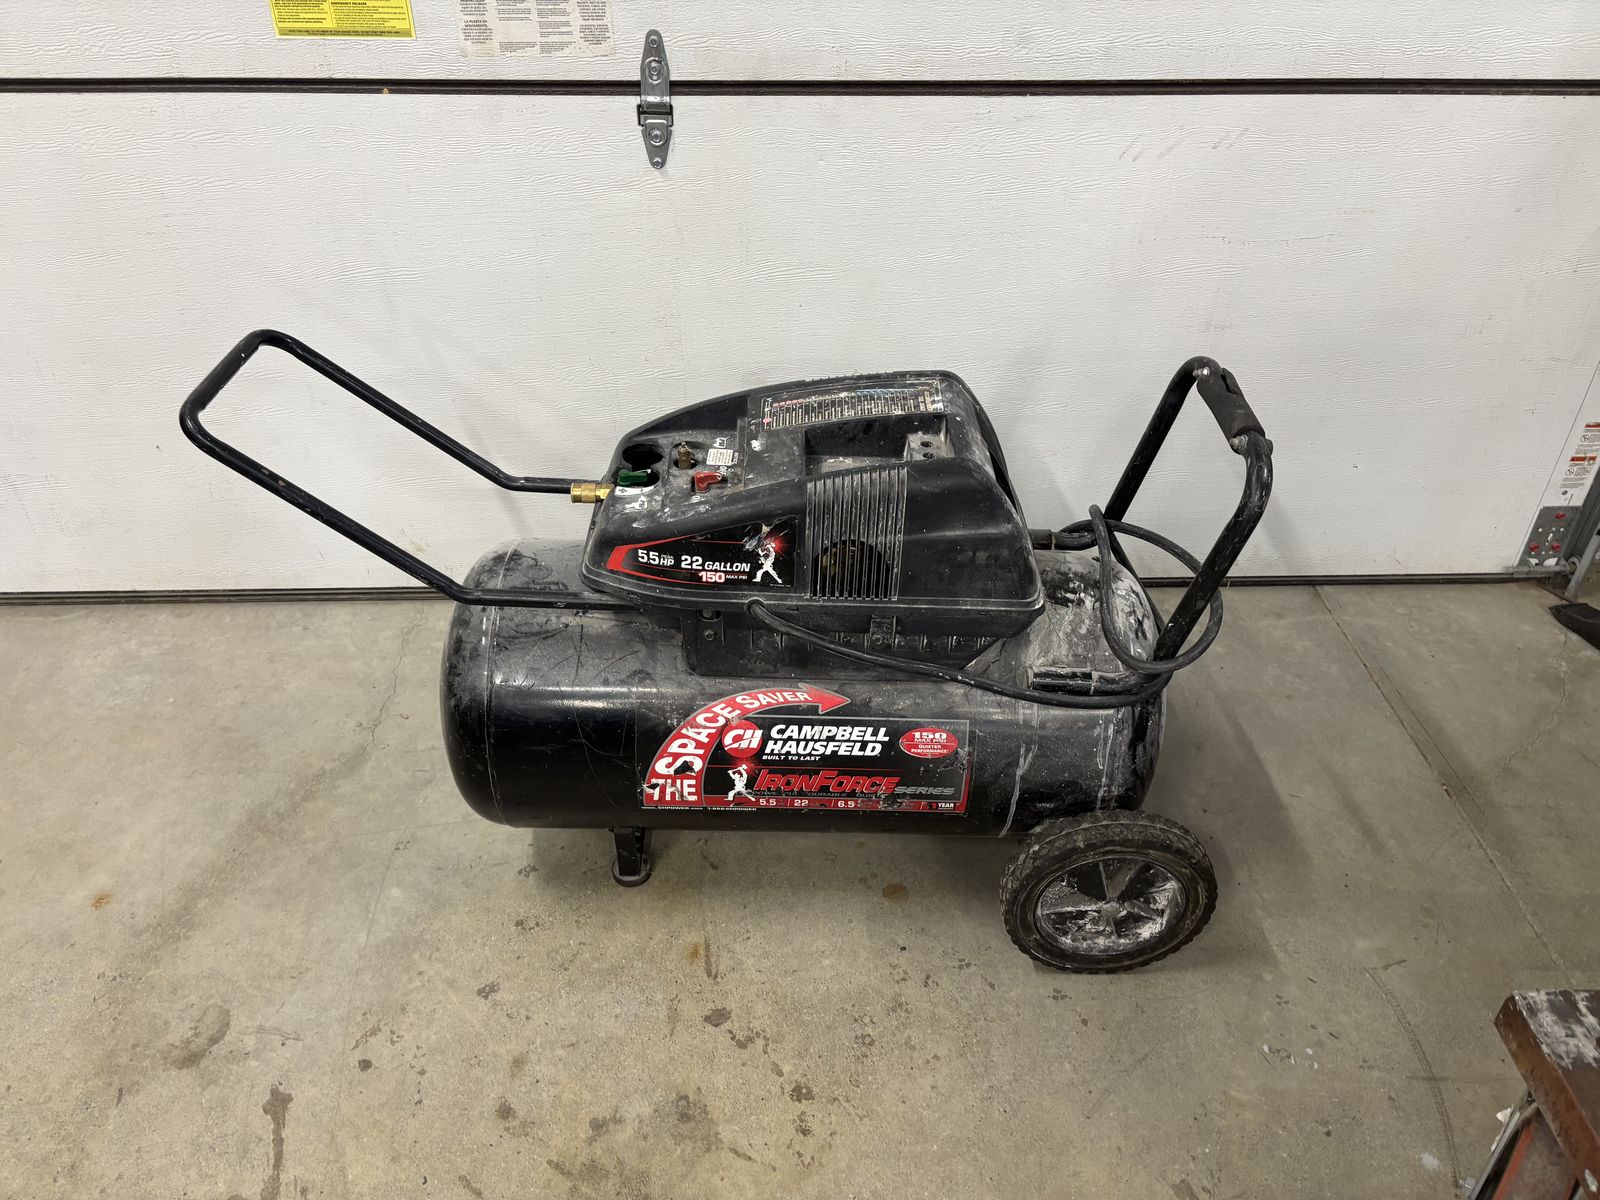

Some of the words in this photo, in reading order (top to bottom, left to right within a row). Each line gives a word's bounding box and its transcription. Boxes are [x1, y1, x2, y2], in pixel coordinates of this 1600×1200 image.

[638, 549, 659, 565] 5.5
[660, 558, 674, 566] HP
[681, 555, 702, 569] 22
[704, 562, 750, 572] GALLON
[698, 572, 725, 583] 150
[735, 691, 812, 709] SAVER
[654, 703, 741, 776] SPACE
[770, 724, 889, 742] CAMPBELL
[764, 741, 882, 757] HAUSFELD
[651, 779, 698, 801] THE
[837, 800, 855, 808] 6.5
